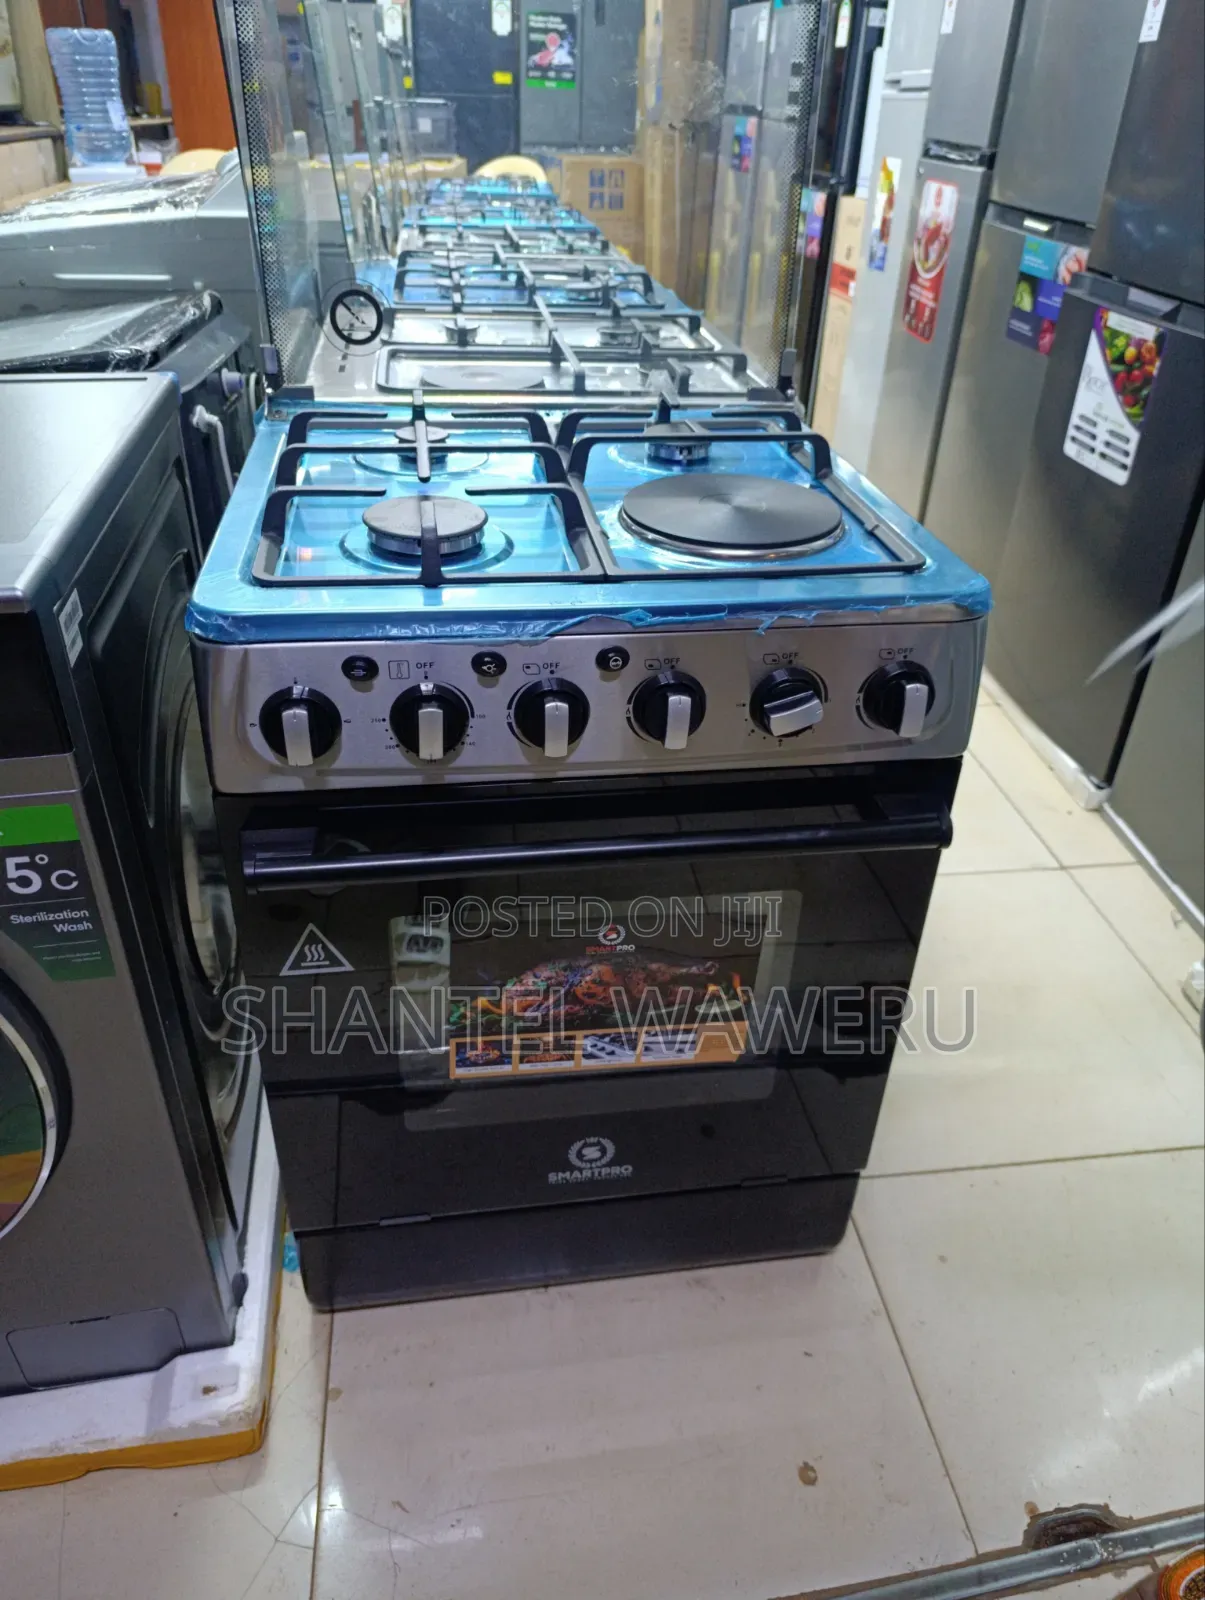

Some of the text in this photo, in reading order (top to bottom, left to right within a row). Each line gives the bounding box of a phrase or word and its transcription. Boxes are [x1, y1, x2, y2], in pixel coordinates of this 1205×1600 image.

[897, 647, 915, 656] OFF
[782, 652, 799, 661] OFF
[416, 661, 436, 670] OFF
[663, 657, 681, 666] OFF
[542, 662, 561, 671] OFF
[10, 908, 90, 925] Sterilization
[53, 920, 94, 933] Wash
[585, 944, 636, 953] SMARTPRO
[547, 1164, 634, 1181] SMARTPRO
